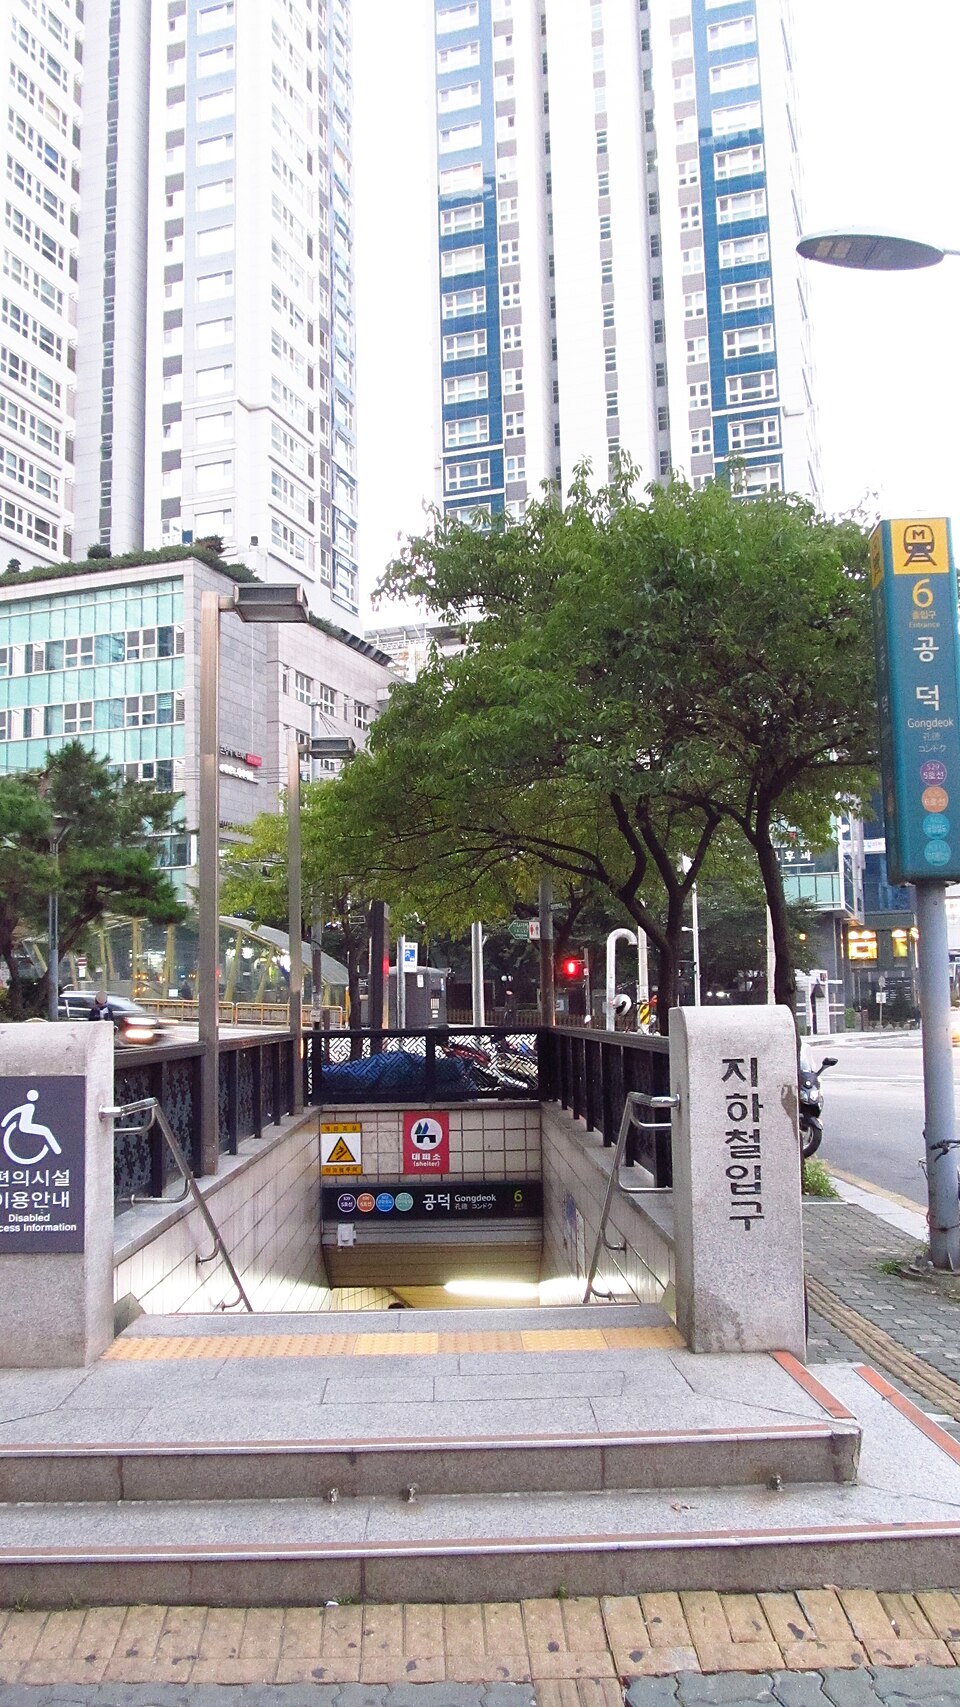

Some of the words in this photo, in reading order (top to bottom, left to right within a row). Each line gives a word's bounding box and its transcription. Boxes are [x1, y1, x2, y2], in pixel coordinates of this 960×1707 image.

[912, 529, 925, 540] M
[912, 578, 934, 608] 6
[913, 636, 940, 711] 공덕
[907, 717, 954, 730] Gongdeok
[721, 1057, 764, 1231] 지하철입구
[411, 1152, 441, 1161] 대피소
[422, 1193, 450, 1211] 공덕
[454, 1194, 497, 1204] Gongdeok
[513, 1189, 523, 1202] 6
[8, 1213, 50, 1222] Disabled
[23, 1222, 77, 1232] Information
